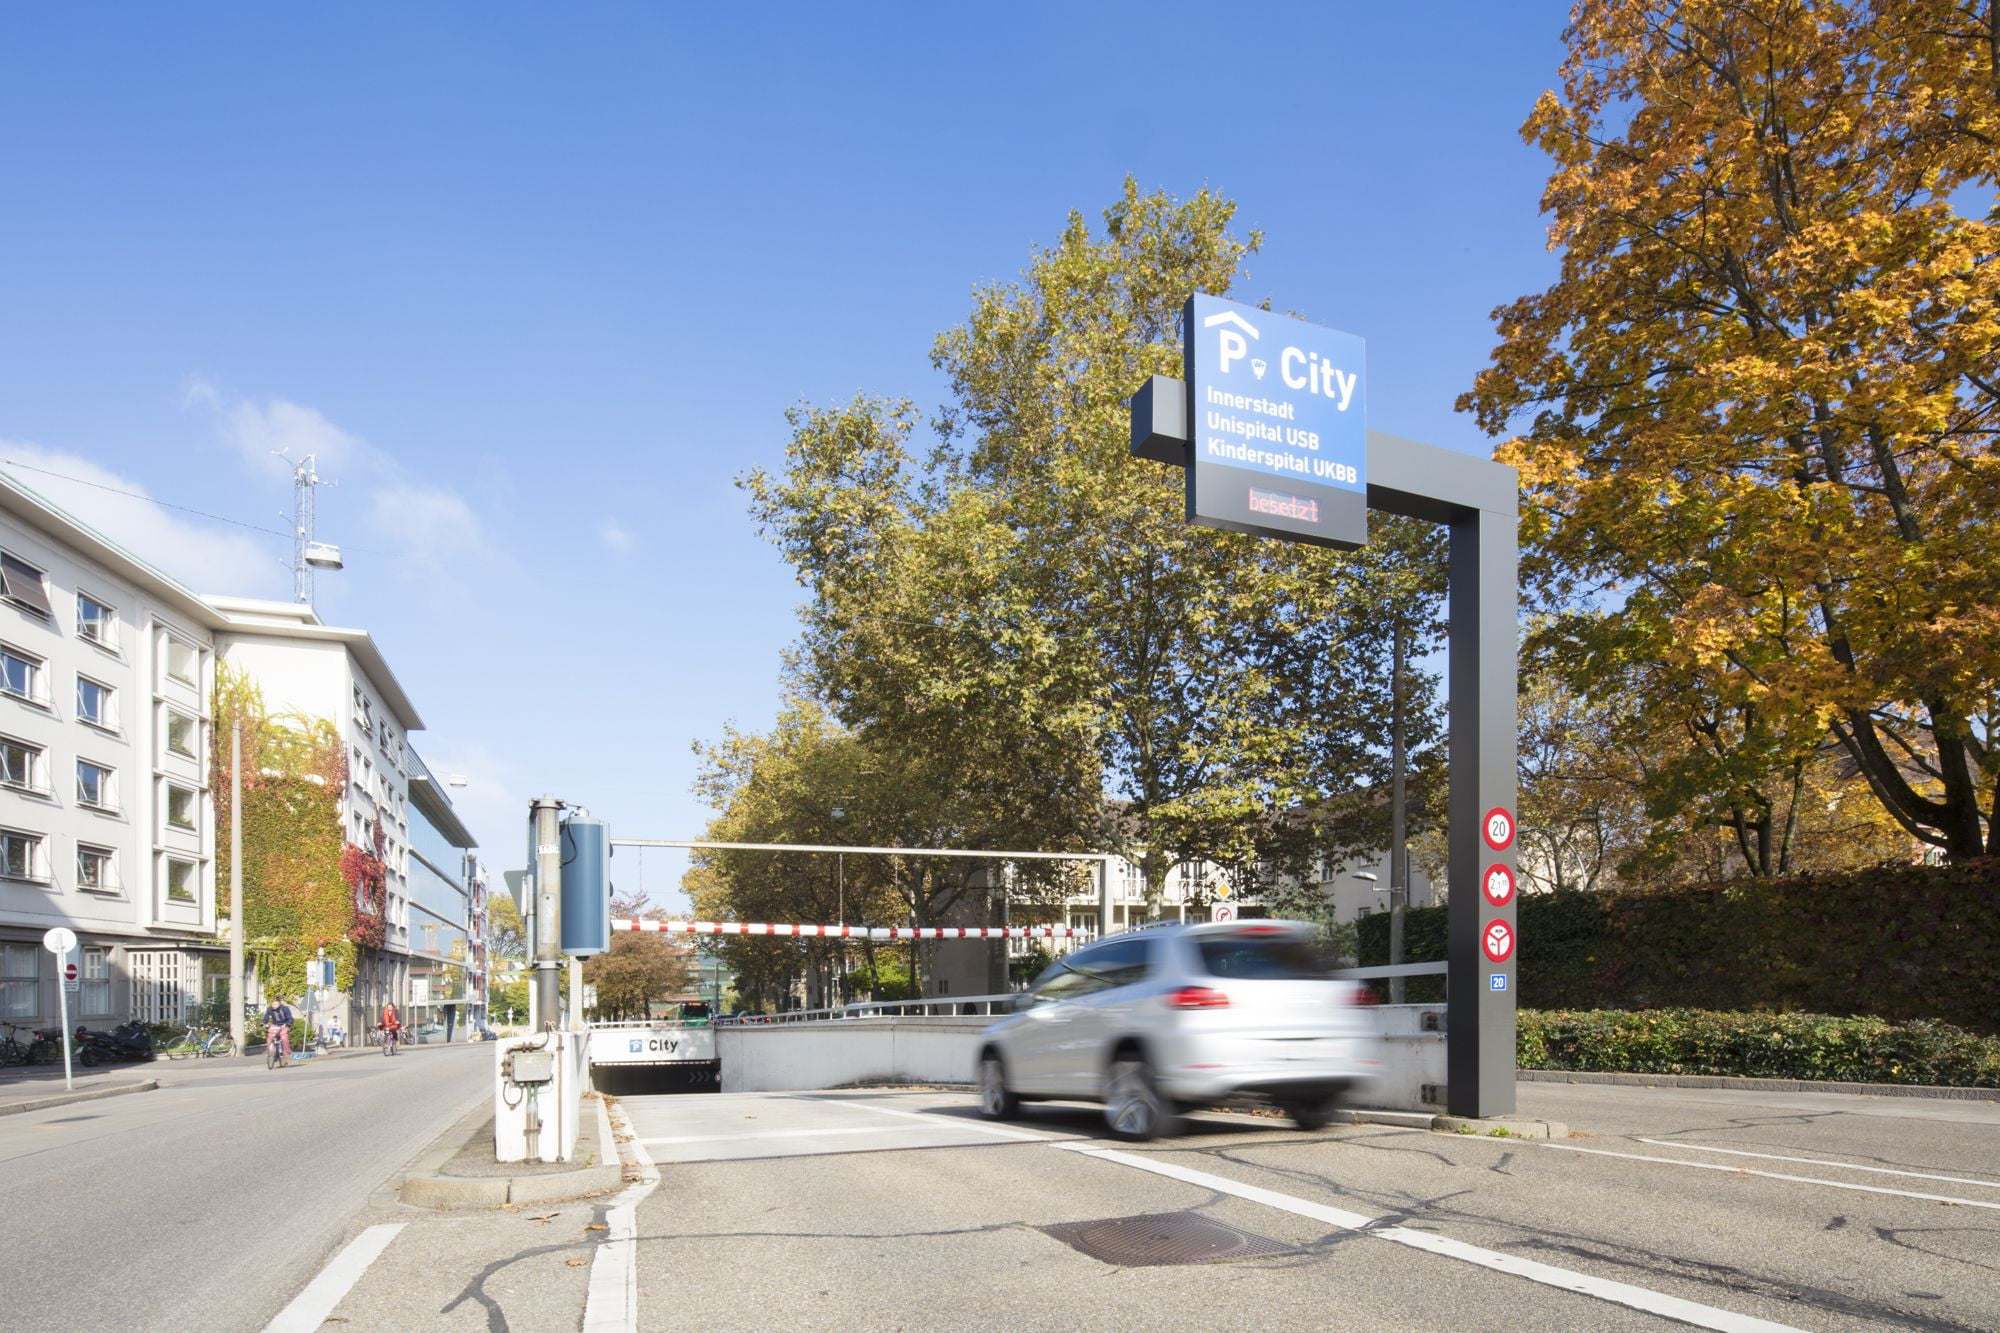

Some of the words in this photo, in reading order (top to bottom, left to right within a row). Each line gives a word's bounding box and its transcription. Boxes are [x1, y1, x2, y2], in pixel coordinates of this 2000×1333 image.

[1220, 329, 1247, 373] P
[1281, 346, 1357, 411] City
[1207, 385, 1294, 420] Innerstadt
[1207, 411, 1282, 443] Unispital
[1286, 427, 1319, 450] USB
[1208, 437, 1310, 474] Kinderspital
[1313, 458, 1357, 484] UKBB
[1249, 487, 1318, 523] besetzt
[1492, 820, 1505, 837] 20
[1493, 977, 1503, 988] 20
[649, 1039, 678, 1053] City
